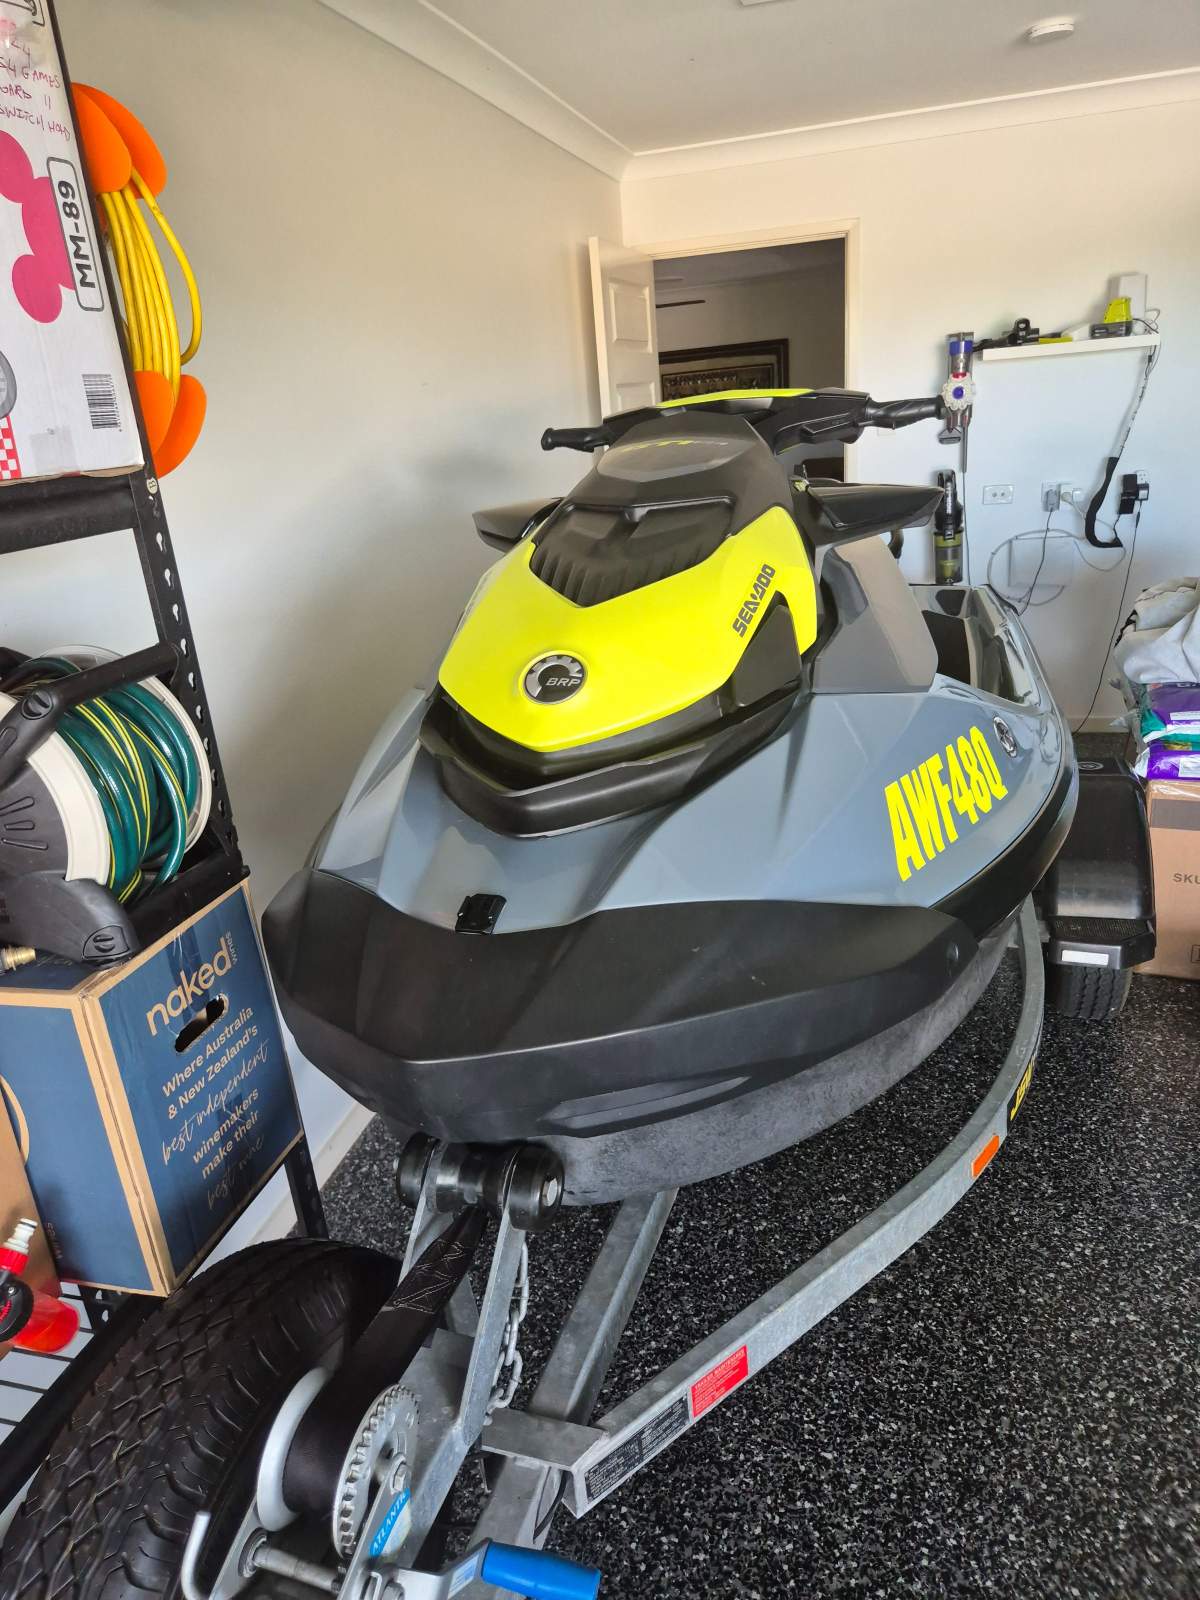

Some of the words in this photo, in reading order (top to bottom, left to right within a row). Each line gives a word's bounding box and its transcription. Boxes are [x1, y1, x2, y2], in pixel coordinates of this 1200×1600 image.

[57, 180, 96, 289] MM-89
[545, 677, 581, 687] BRP
[146, 936, 232, 1036] naked
[162, 1055, 204, 1097] Where
[205, 1007, 254, 1059] Australia
[168, 1103, 178, 1120] &
[178, 1077, 205, 1109] New
[206, 1025, 258, 1082] Zealand's
[162, 1113, 197, 1166] best
[196, 1039, 269, 1126] independent
[193, 1088, 259, 1164] winemakers
[202, 1140, 233, 1179] make
[234, 1110, 259, 1142] their
